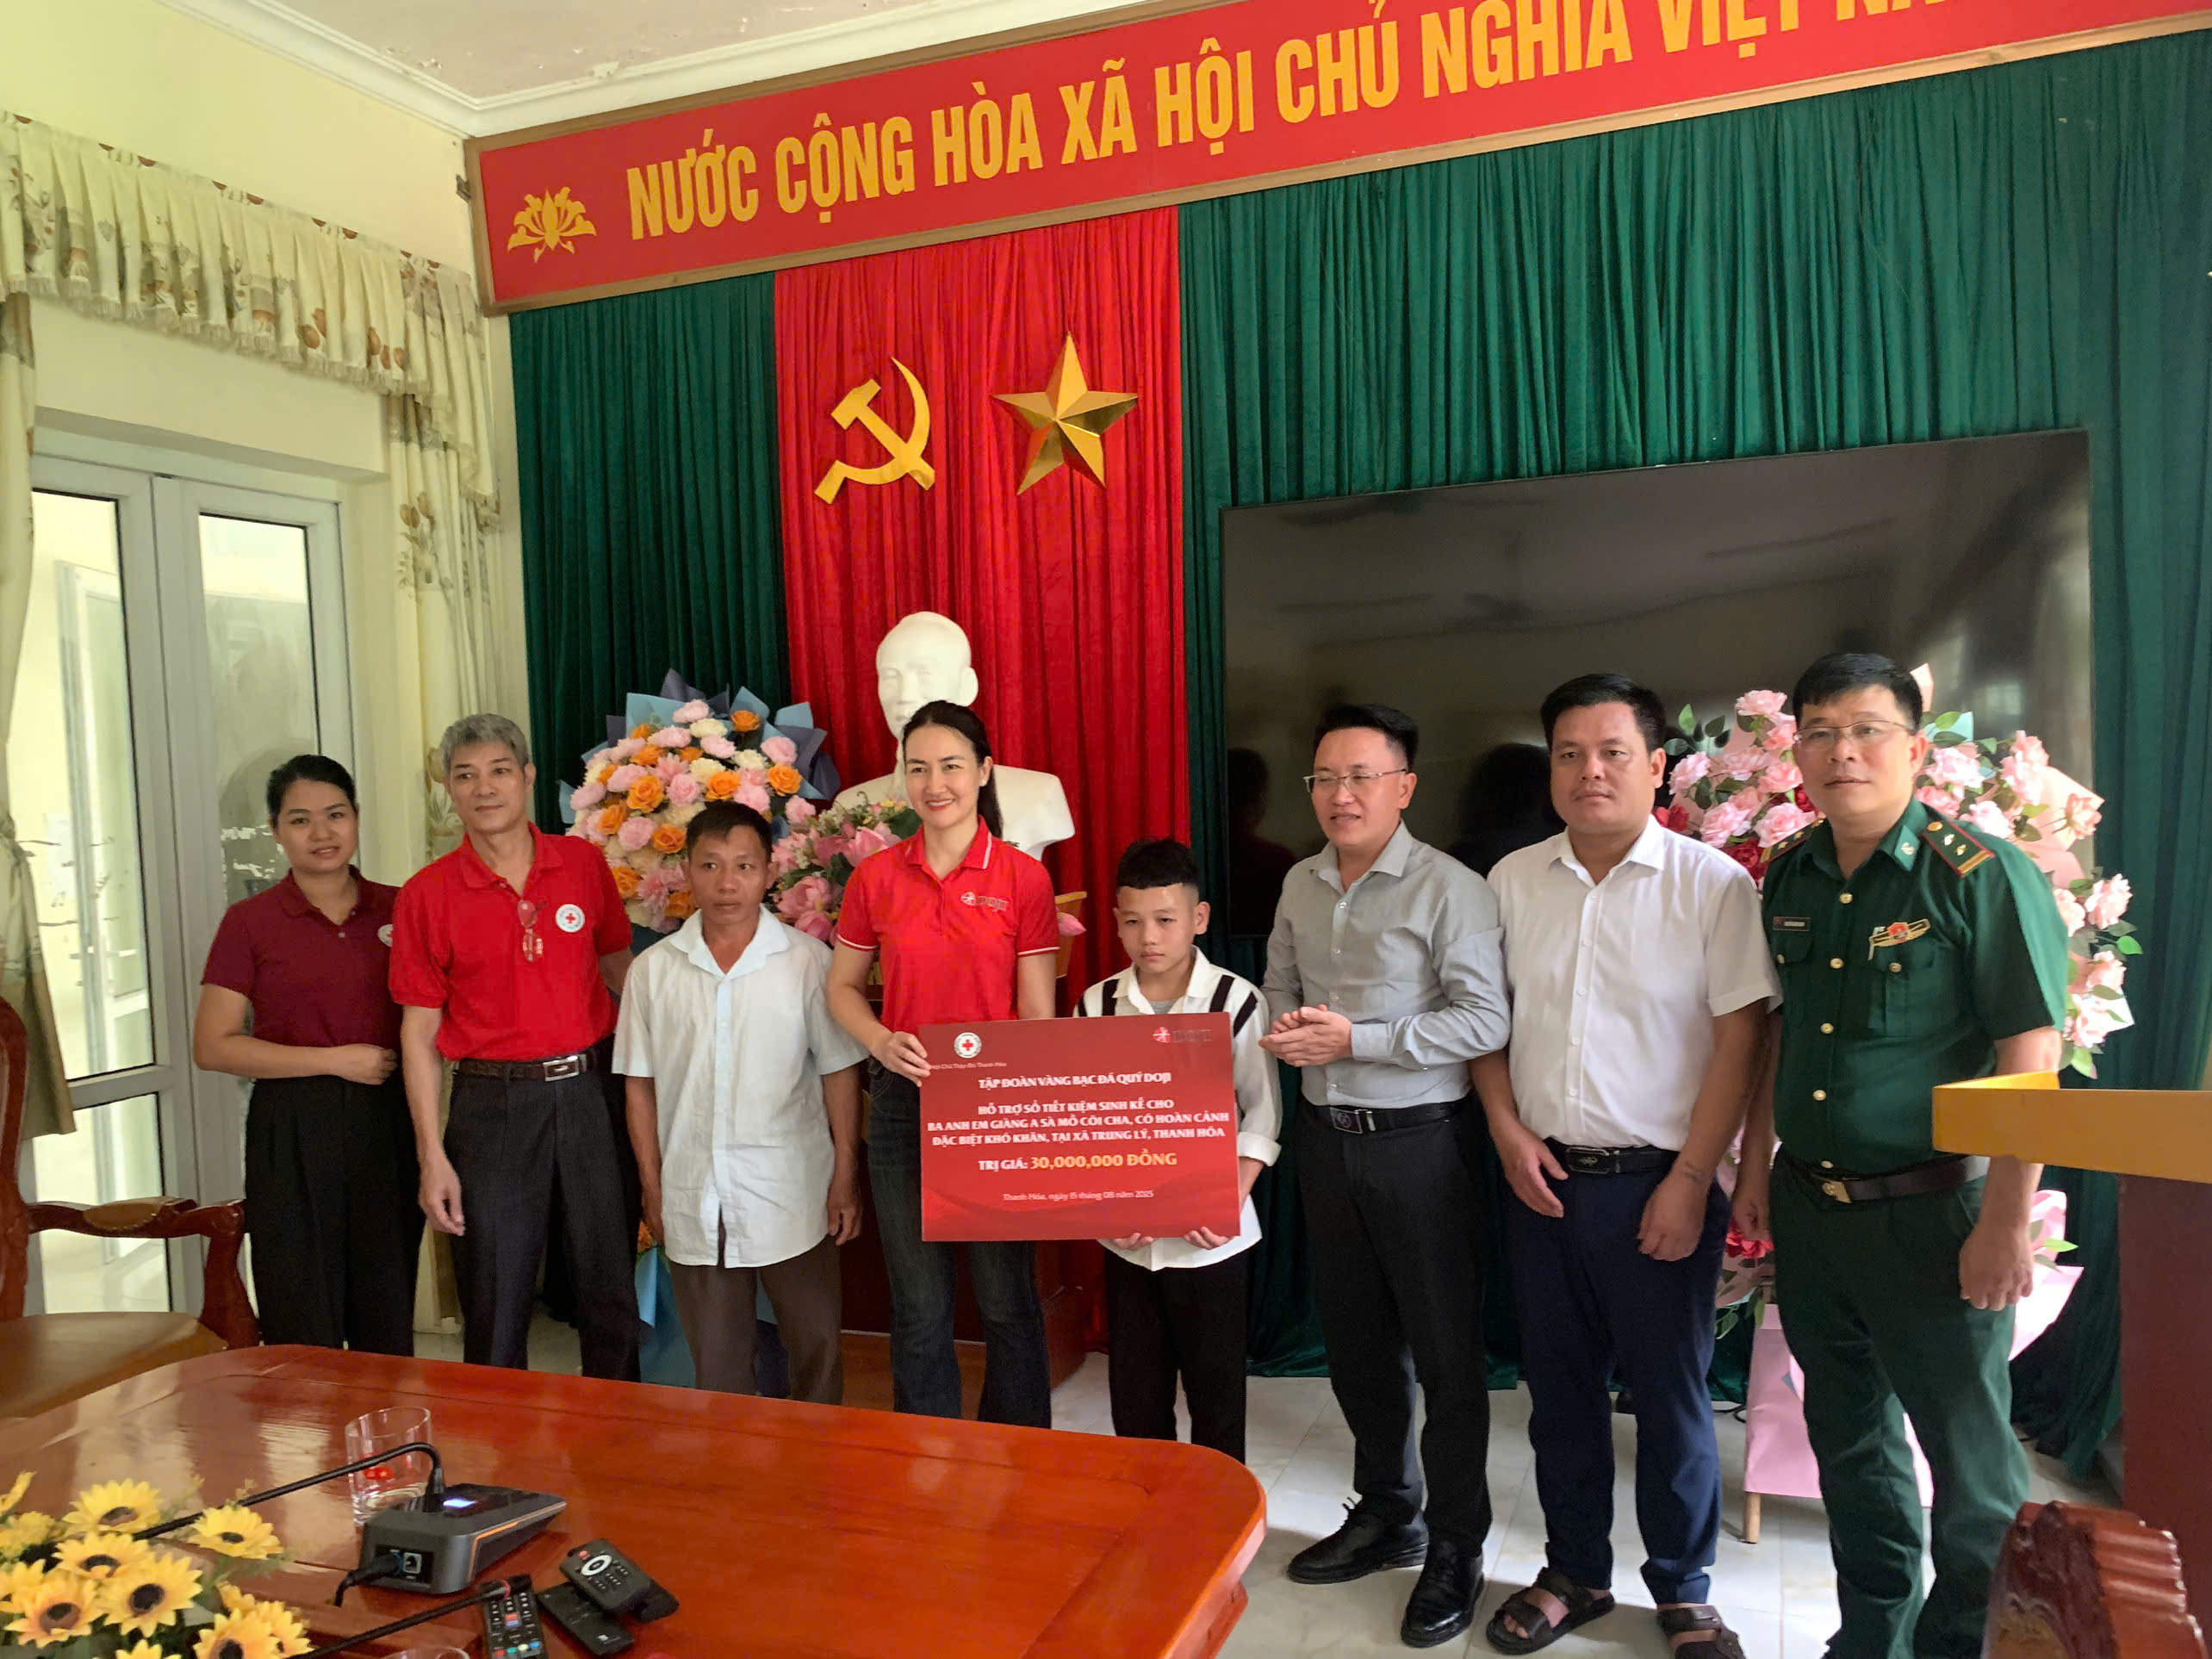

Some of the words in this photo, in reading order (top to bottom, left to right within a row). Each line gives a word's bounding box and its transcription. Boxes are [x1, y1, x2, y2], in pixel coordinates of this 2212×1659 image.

[626, 128, 759, 240] NƯỚC
[774, 113, 916, 224] CỘNG
[931, 82, 1043, 187] HÒA
[1060, 59, 1138, 165] XÃ
[1155, 38, 1255, 155] HỘI
[1276, 0, 1400, 123] CHỦ
[979, 1077, 1001, 1090] TẬP
[1002, 1075, 1036, 1089] ĐOÀN
[1038, 1074, 1072, 1086] VÀNG
[1073, 1075, 1097, 1087] BẠC
[1097, 1072, 1115, 1084] ĐÁ
[1116, 1072, 1144, 1085] QUÝ
[1144, 1072, 1171, 1084] DOJI
[997, 1103, 1022, 1116] TRỢ
[1042, 1100, 1066, 1113] TIẾT
[1067, 1100, 1097, 1113] KIỆM
[1097, 1101, 1128, 1110] SINH
[1130, 1097, 1145, 1109] KẾ
[1146, 1099, 1175, 1109] CHO
[927, 1122, 944, 1132] BA
[944, 1122, 970, 1130] ANH
[972, 1121, 989, 1130] EM
[1030, 1119, 1039, 1128] A
[1080, 1115, 1103, 1127] CÔI
[1104, 1116, 1134, 1126] CHA,
[1134, 1113, 1154, 1124] CÓ
[1156, 1111, 1192, 1123] HOÀN
[1194, 1110, 1230, 1123] CẢNH
[932, 1135, 957, 1147] ĐẶC
[958, 1134, 984, 1147] BIỆT
[984, 1132, 1011, 1144] KHÓ
[1051, 1132, 1070, 1144] TẠI
[1072, 1130, 1090, 1141] XÃ
[1090, 1130, 1133, 1140] TRUNG
[1153, 1128, 1196, 1139] THANH
[1196, 1126, 1226, 1138] HÓA
[979, 1159, 999, 1171] TRỊ
[1000, 1158, 1028, 1170] GIÁ:
[1030, 1154, 1123, 1171] 30,000,000
[1127, 1148, 1177, 1166] ĐỒNG
